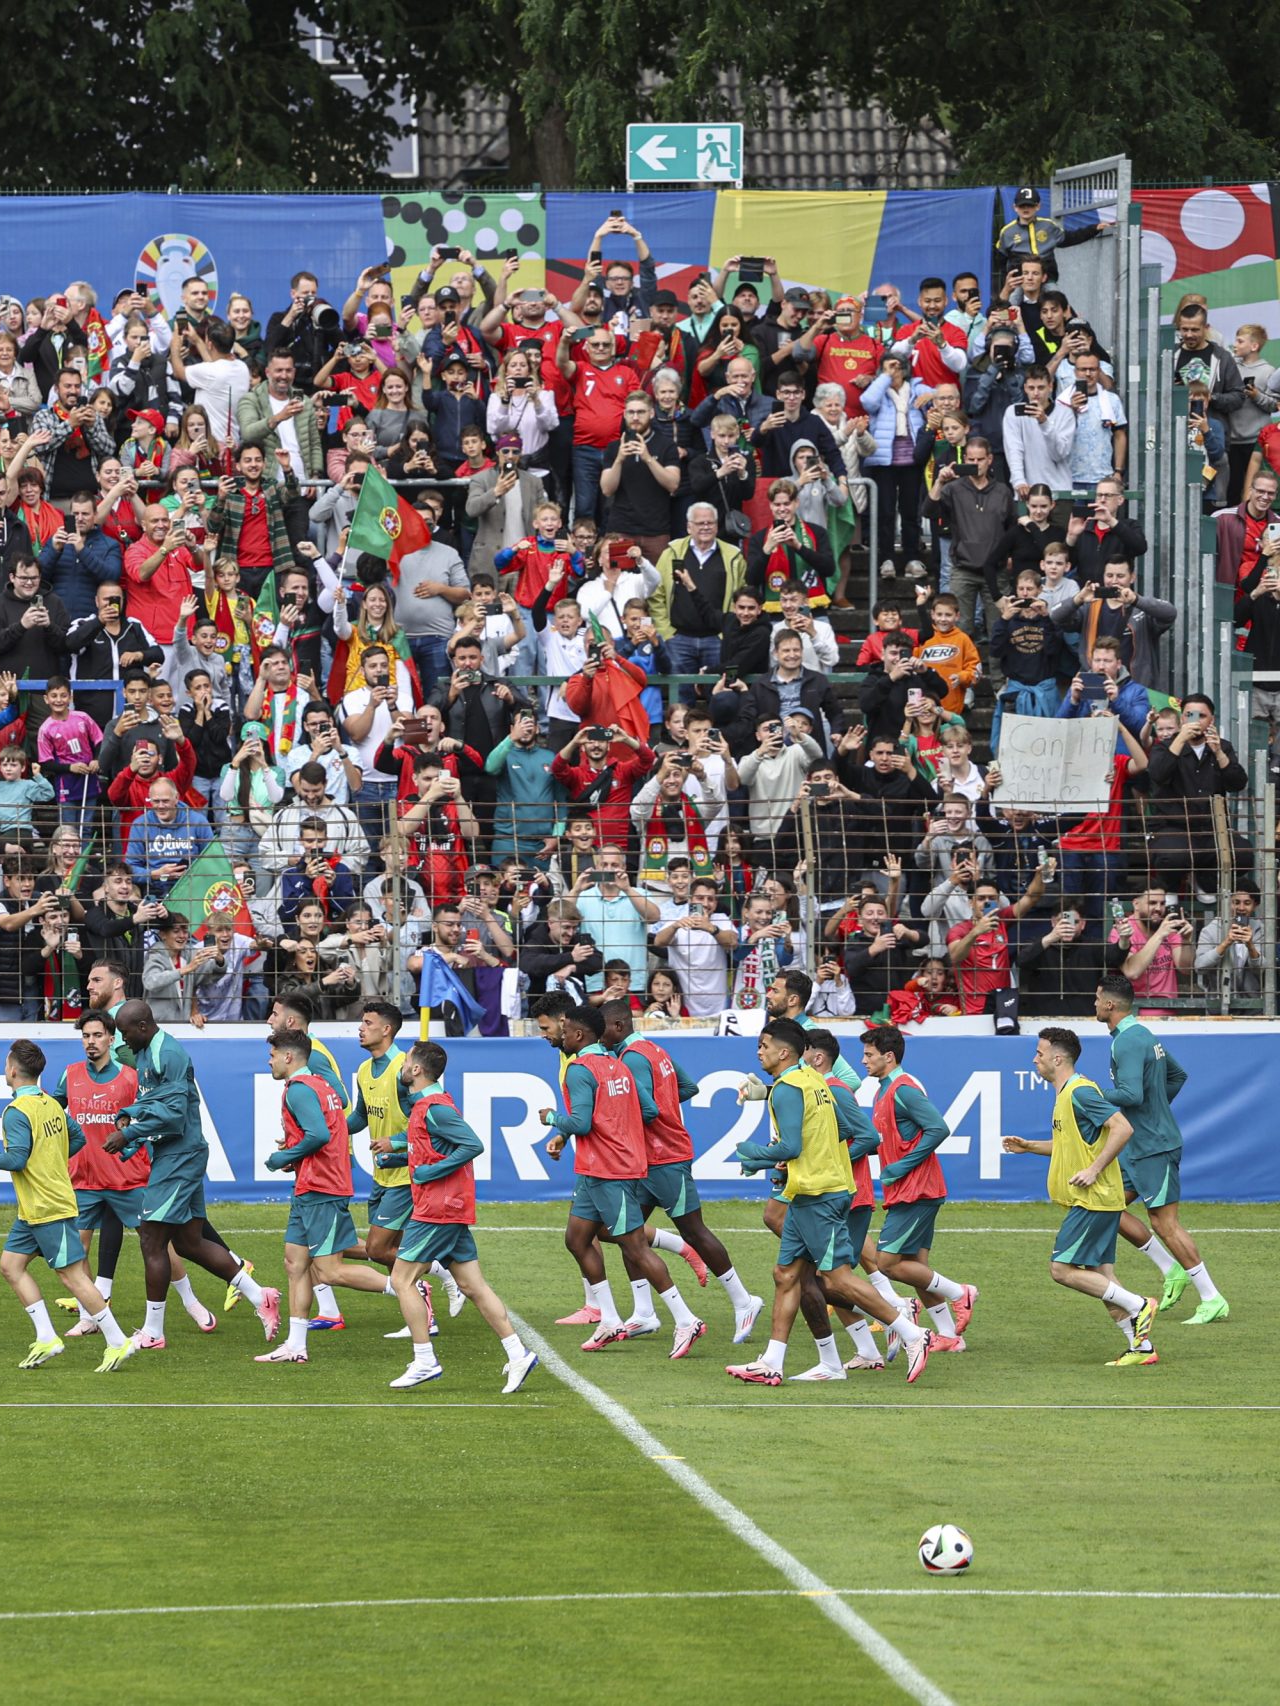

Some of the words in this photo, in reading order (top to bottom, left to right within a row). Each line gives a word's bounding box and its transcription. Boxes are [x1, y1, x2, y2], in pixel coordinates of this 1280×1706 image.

[585, 380, 595, 397] 7
[921, 649, 958, 661] NERF
[1009, 723, 1063, 757] Can
[606, 1076, 630, 1097] MEO
[326, 1093, 343, 1111] ME
[813, 1088, 831, 1106] ME
[42, 1116, 63, 1138] MEO
[85, 1113, 117, 1125] SAGRES
